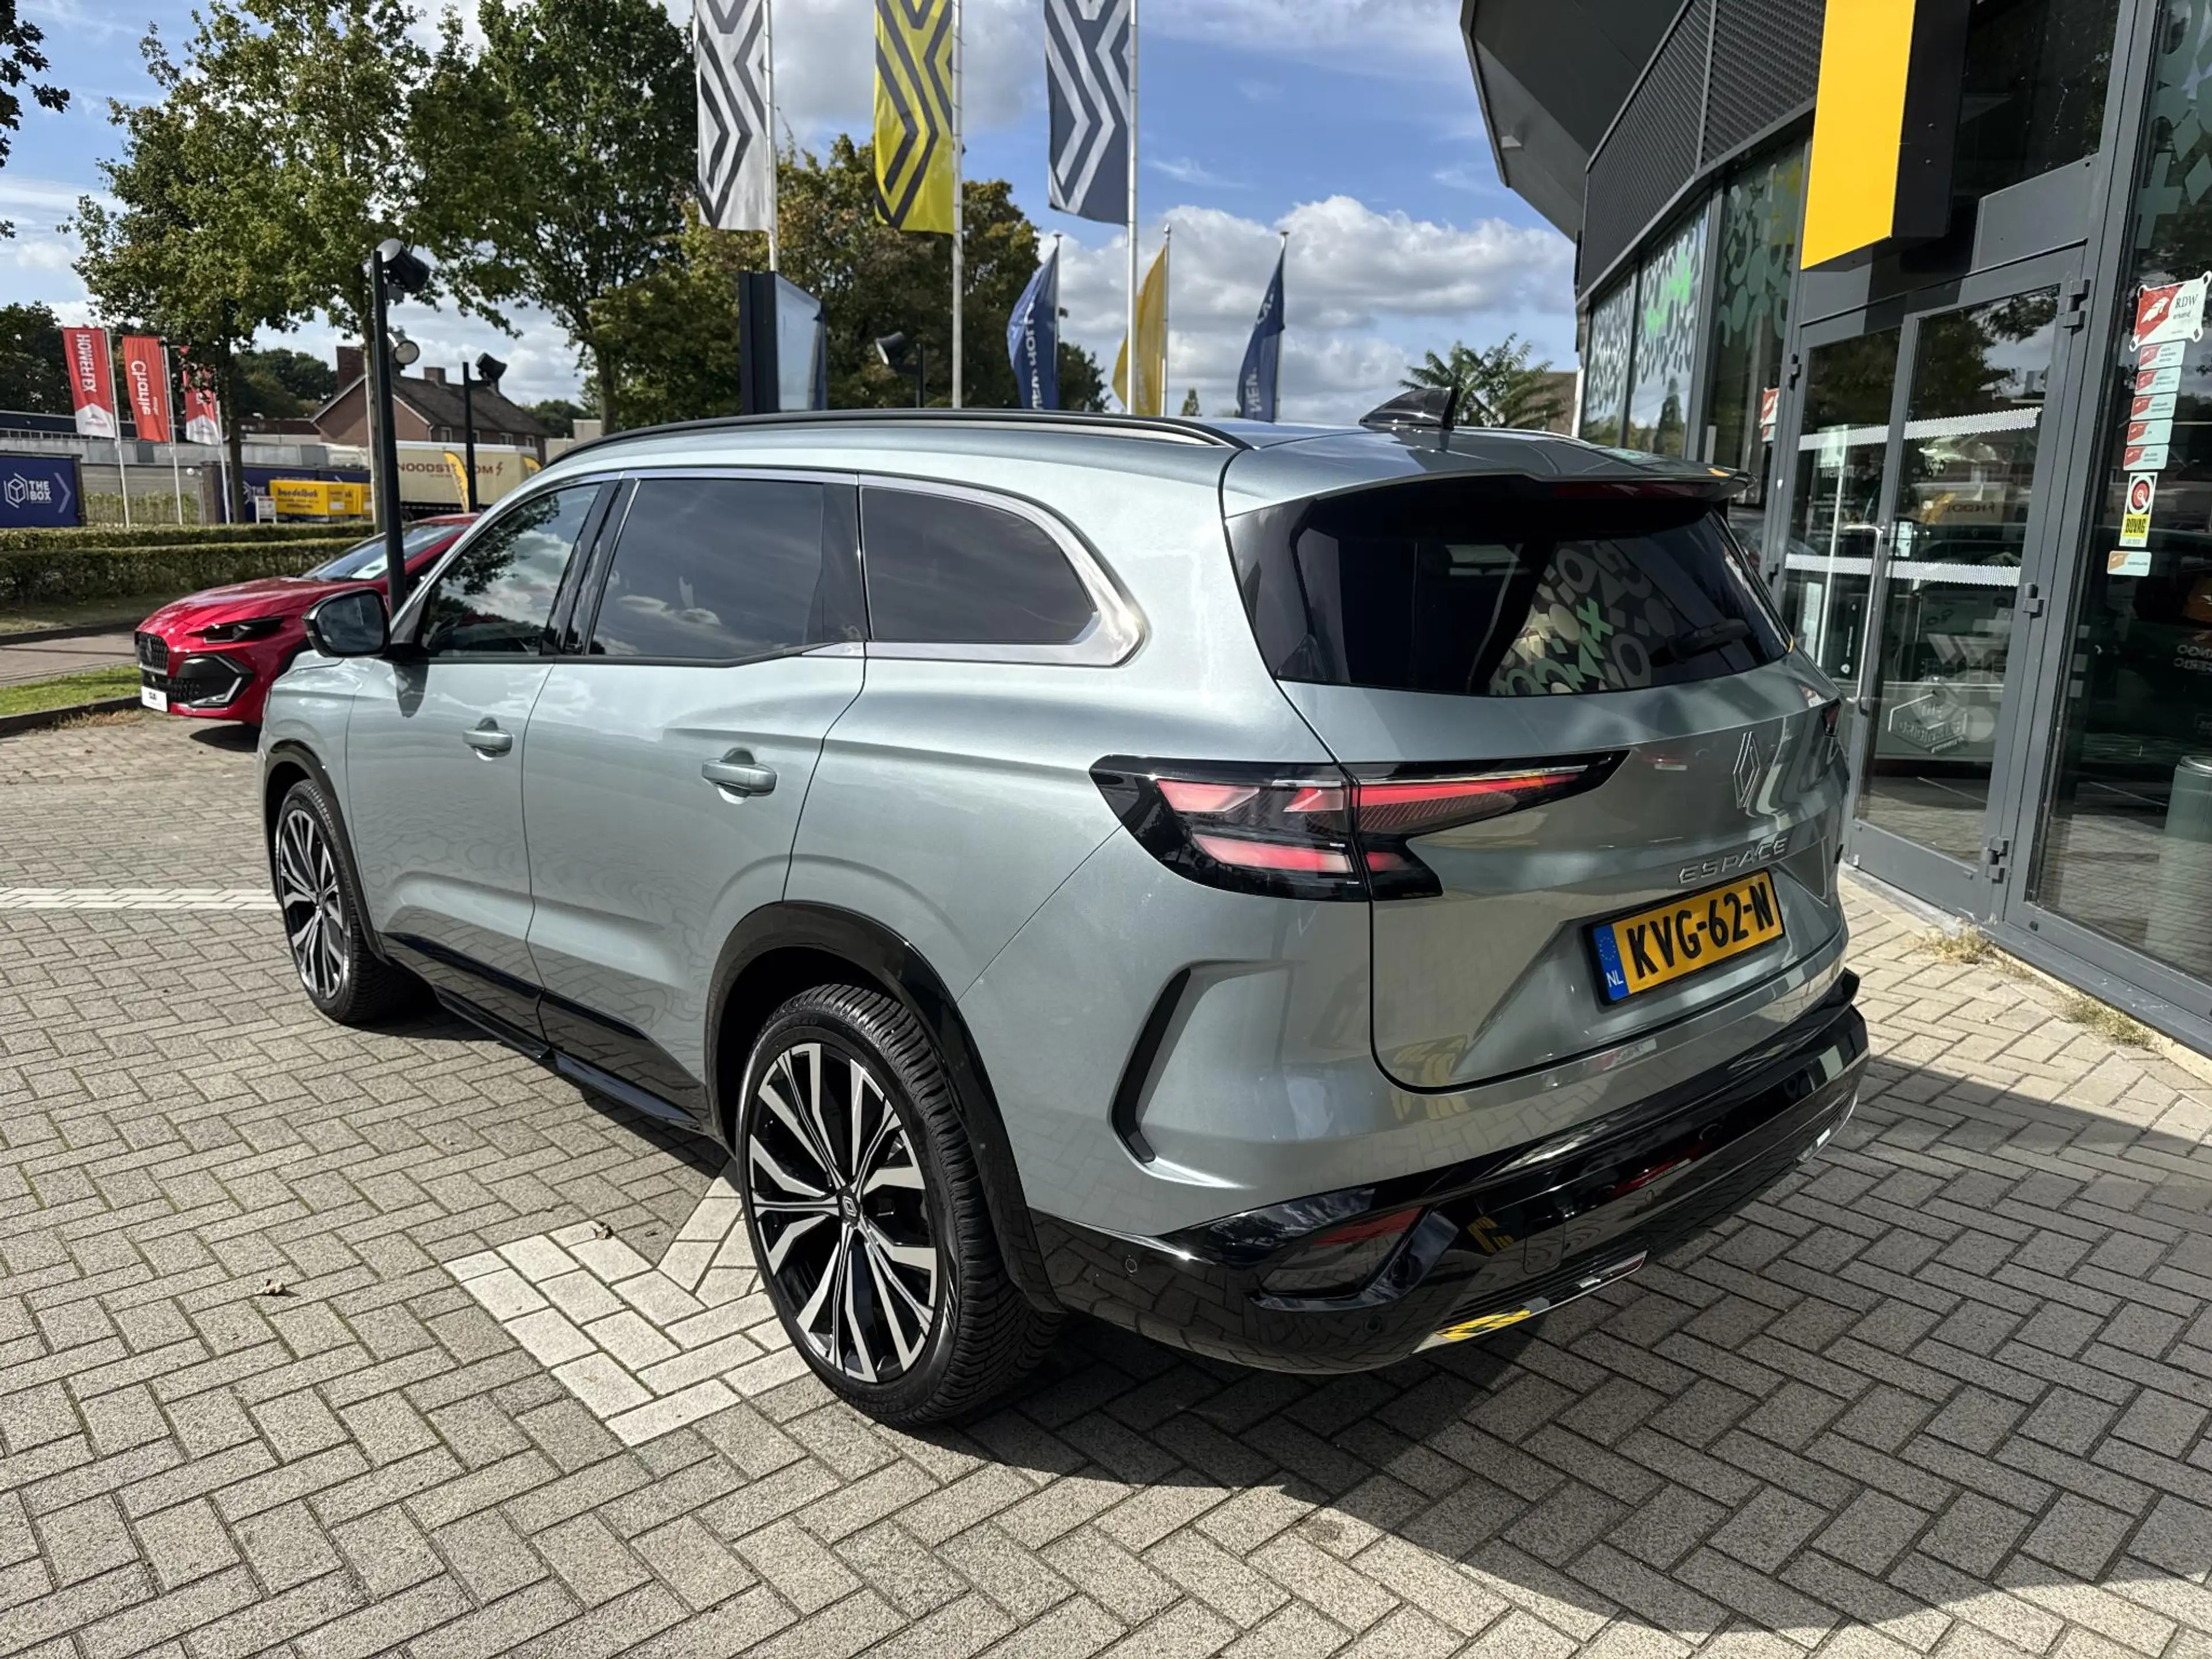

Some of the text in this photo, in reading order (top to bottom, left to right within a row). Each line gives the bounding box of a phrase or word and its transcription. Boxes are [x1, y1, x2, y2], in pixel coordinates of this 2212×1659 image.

[2175, 293, 2199, 309] RDW
[398, 463, 493, 474] NOODSTOM
[28, 480, 50, 491] THE
[30, 491, 52, 501] BOX
[2126, 517, 2147, 534] BOVAG
[1677, 837, 1788, 885] ESPACE
[1626, 882, 1775, 980] KVG-62-N
[1607, 972, 1624, 988] NL
